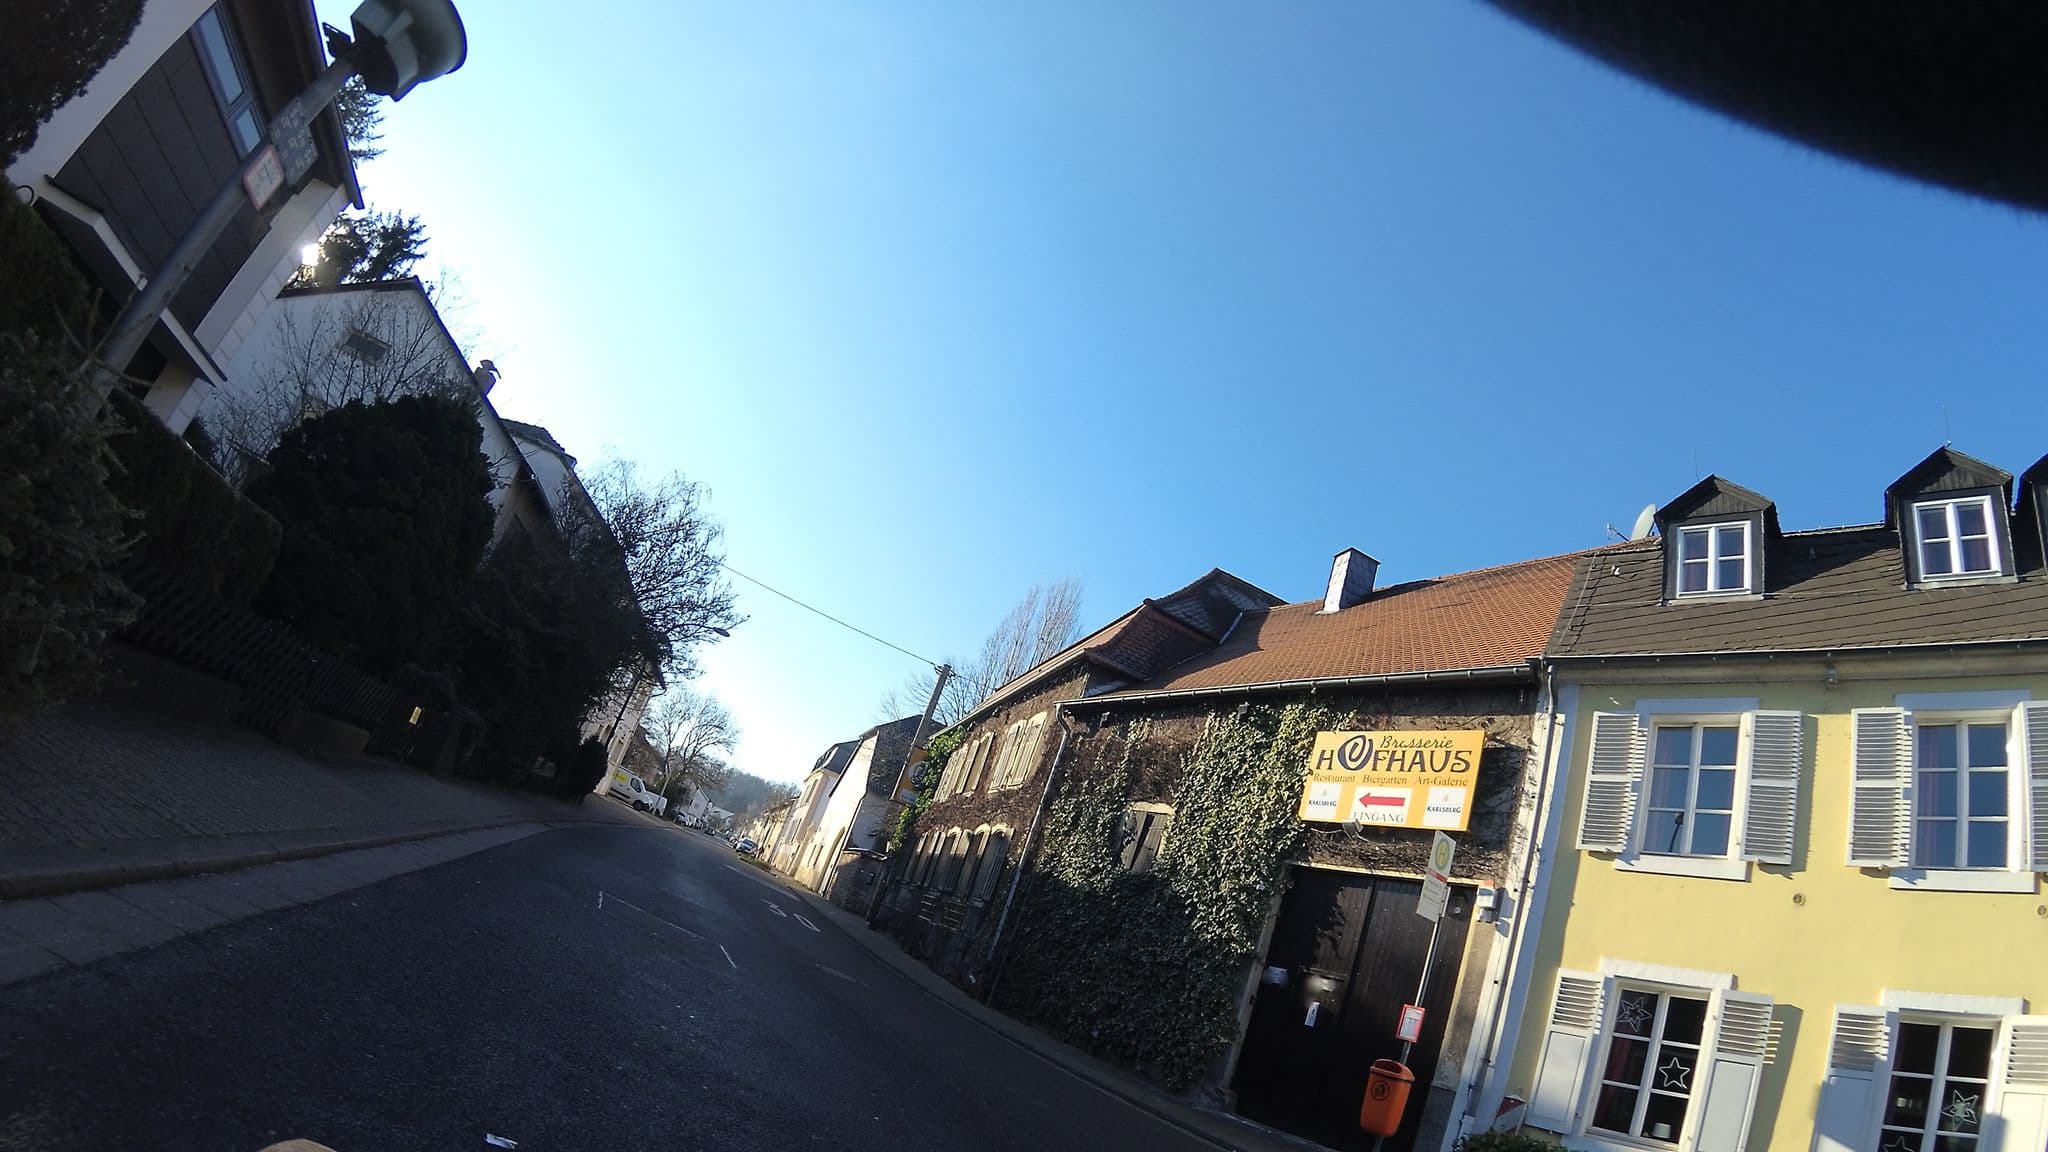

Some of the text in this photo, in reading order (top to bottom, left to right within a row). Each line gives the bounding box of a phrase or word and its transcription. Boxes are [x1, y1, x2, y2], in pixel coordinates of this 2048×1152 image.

[1380, 735, 1454, 748] Brasserie
[1315, 735, 1472, 773] HOFHAUS
[1313, 773, 1468, 787] Restaurant Biergarten Art-Galerie
[1308, 799, 1337, 807] KARLSBERG
[1426, 806, 1462, 814] KARLSBERG
[1353, 811, 1404, 823] EINGANG
